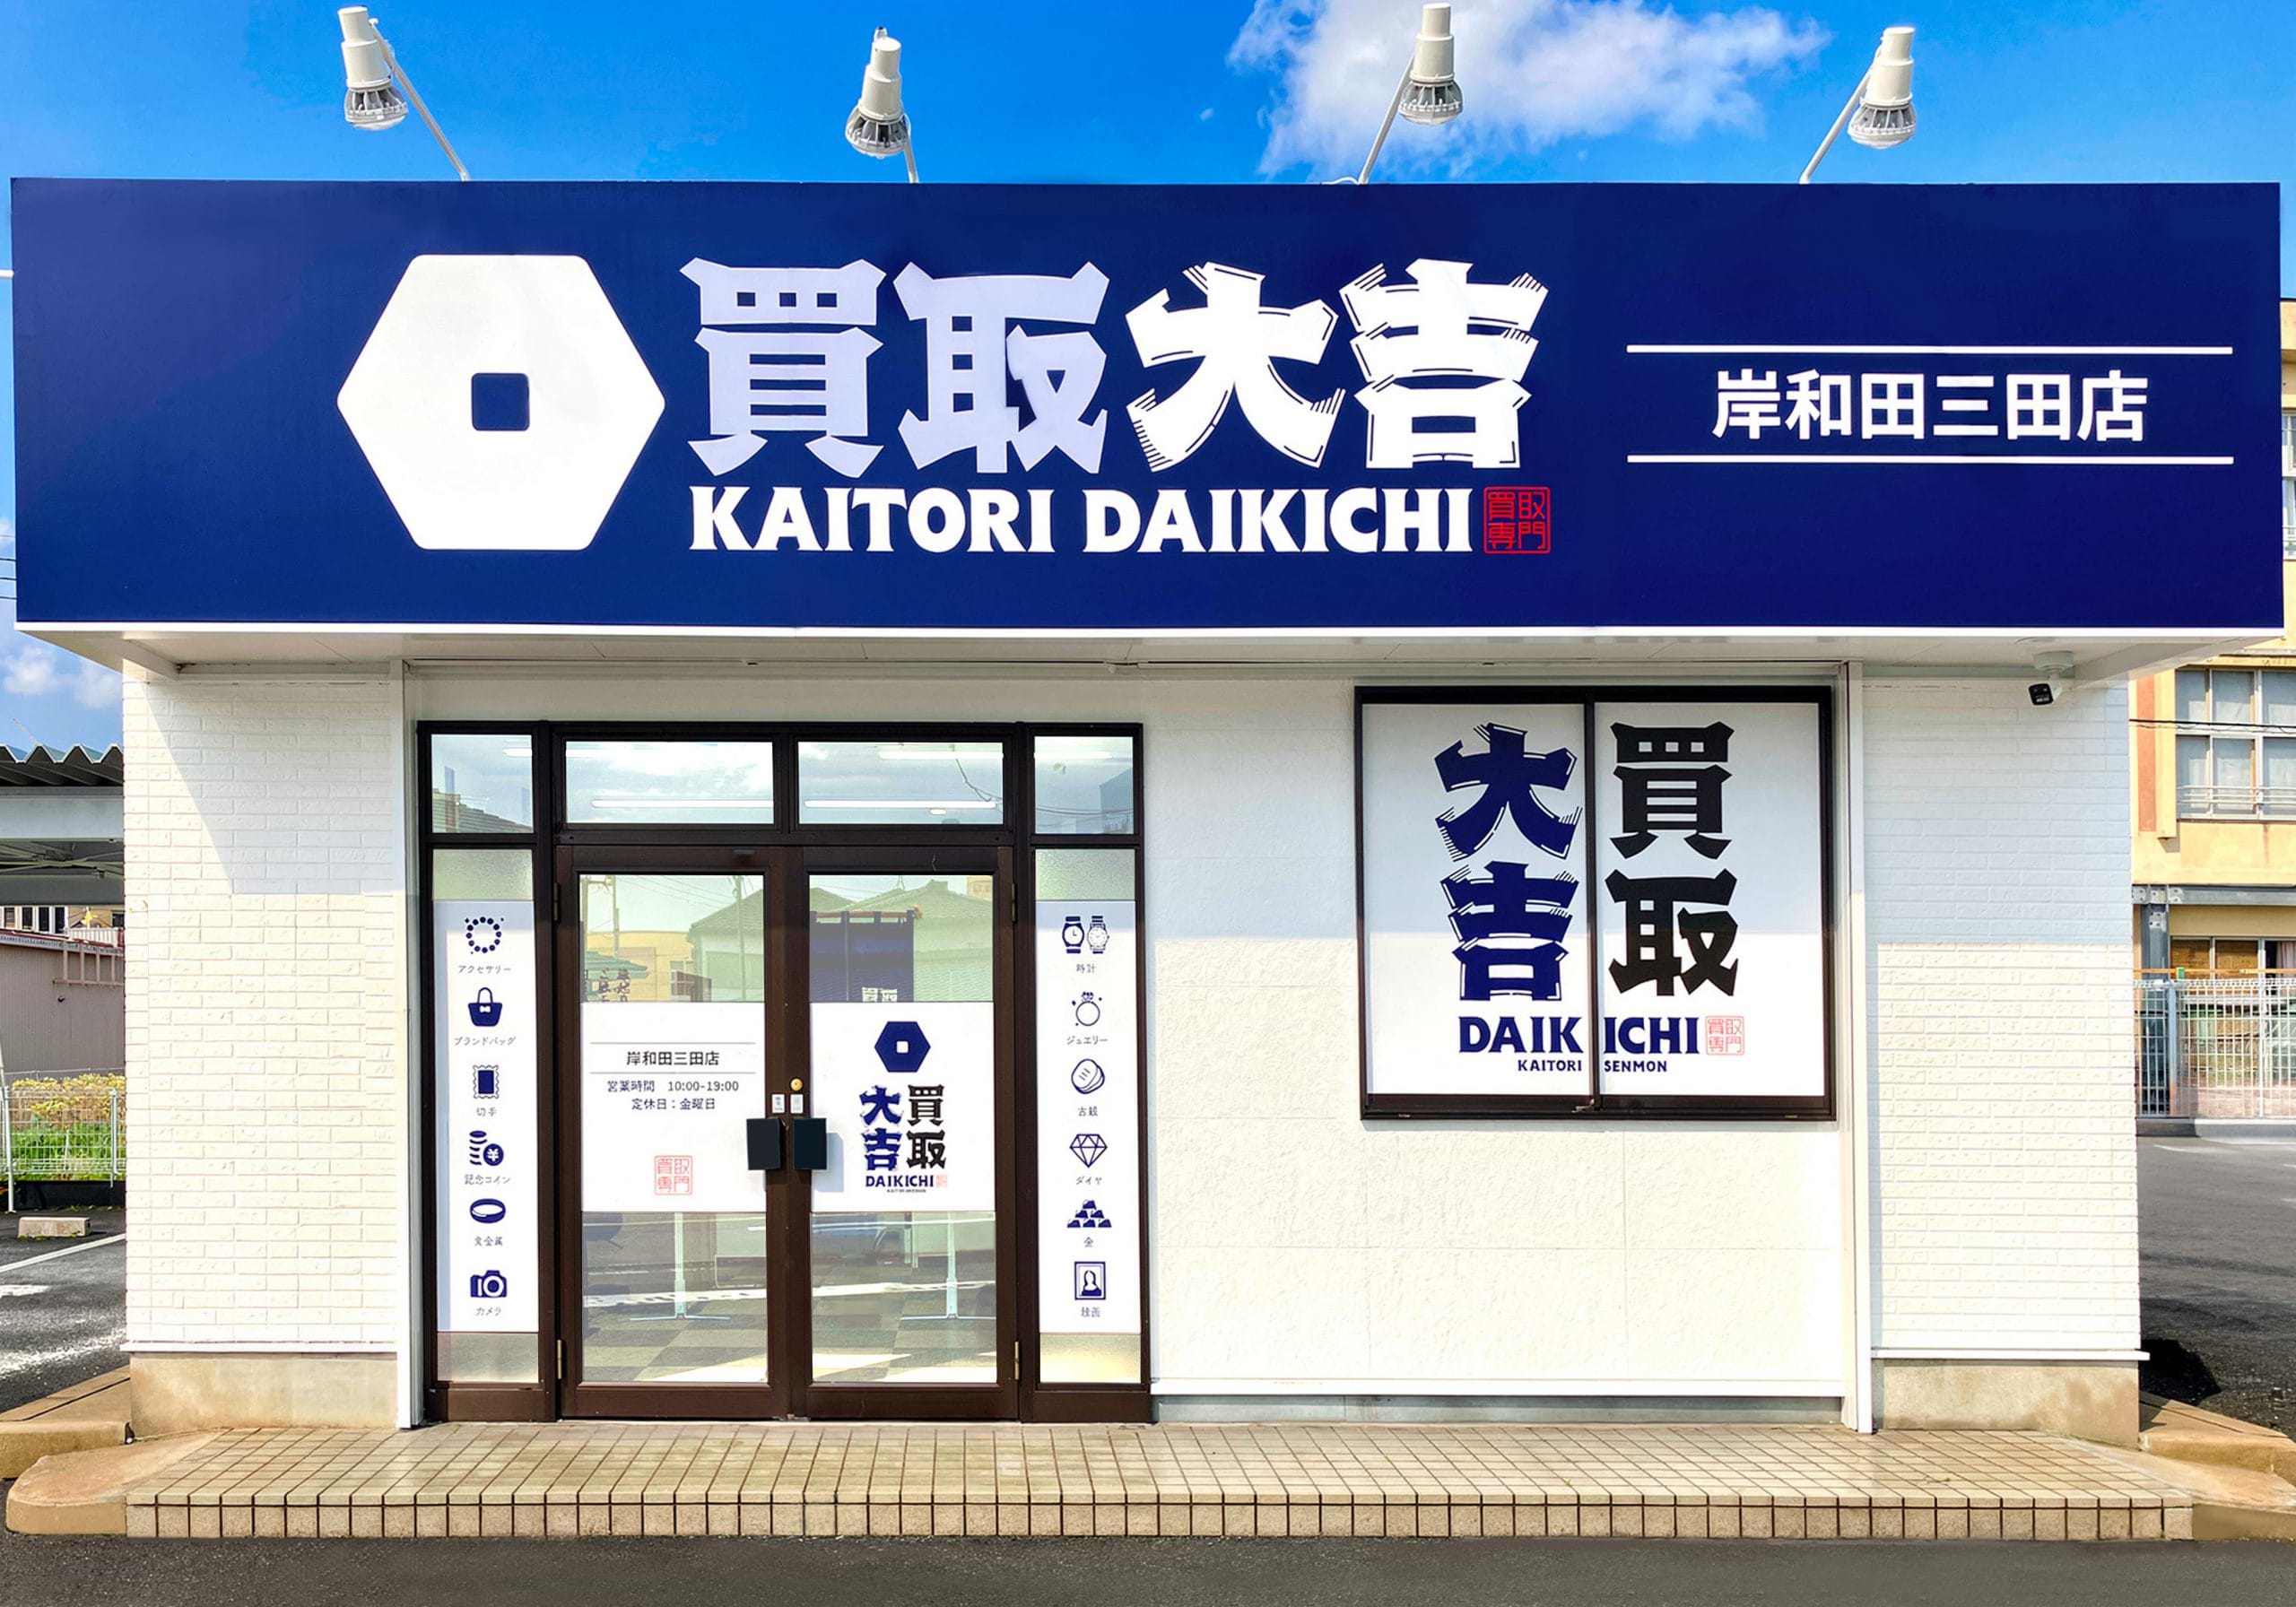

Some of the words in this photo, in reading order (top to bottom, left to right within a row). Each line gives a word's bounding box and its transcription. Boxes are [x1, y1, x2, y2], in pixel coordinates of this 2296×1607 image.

[1712, 369, 2148, 441] 岸和田三田店
[689, 486, 1056, 553] KAITORI
[1082, 487, 1473, 553] DAIKICHI
[458, 965, 511, 974] アクセサリー
[1066, 1036, 1109, 1046] ジュエリー
[626, 1051, 719, 1066] 岸和田三田店
[1518, 1059, 1582, 1072] KAITORI
[1604, 1059, 1667, 1073] SENMON
[607, 1081, 655, 1092] 営業時間
[865, 1175, 934, 1187] DAIKICHI
